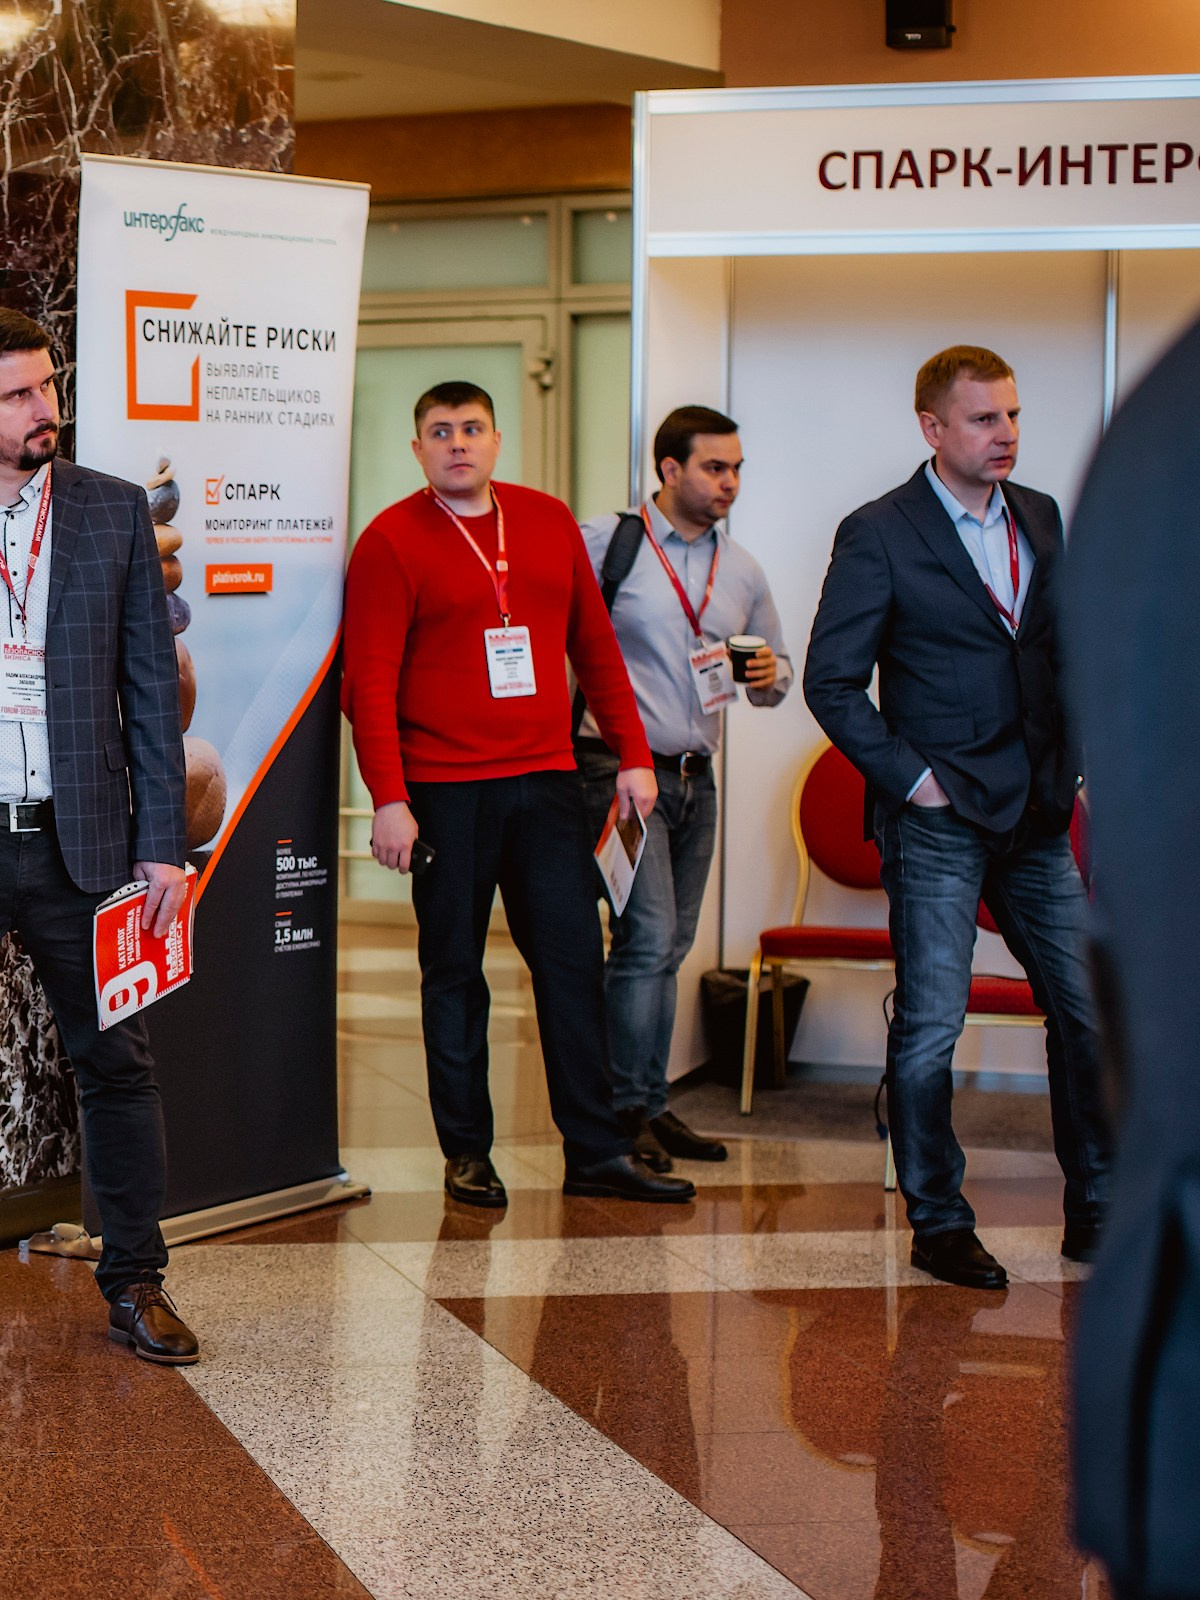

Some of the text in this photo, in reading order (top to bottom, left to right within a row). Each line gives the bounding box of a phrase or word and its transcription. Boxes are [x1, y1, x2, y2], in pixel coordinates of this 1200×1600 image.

[818, 142, 1200, 190] СПАРК-ИНТЕР
[143, 316, 336, 352] СНИЖАЙТЕ РИСКИ
[206, 362, 280, 380] ВЫЯВЛЯЙТЕ
[206, 385, 321, 404] НЕПЛАТЕЛЬЩИКОВ
[206, 408, 335, 429] НА РАННИХ СТАДИЯХ
[225, 483, 281, 500] СПАРК
[205, 516, 334, 531] МОНИТОРИНГ ПЛАТЕЖЕЙ
[4, 647, 46, 658] БЕЗОПАСНОС
[276, 856, 295, 872] 500
[126, 908, 136, 966] УЧАСТНИКА
[275, 928, 291, 945] 1,5
[117, 928, 127, 970] КАТАЛОГ
[176, 920, 184, 973] БИЗНЕСА
